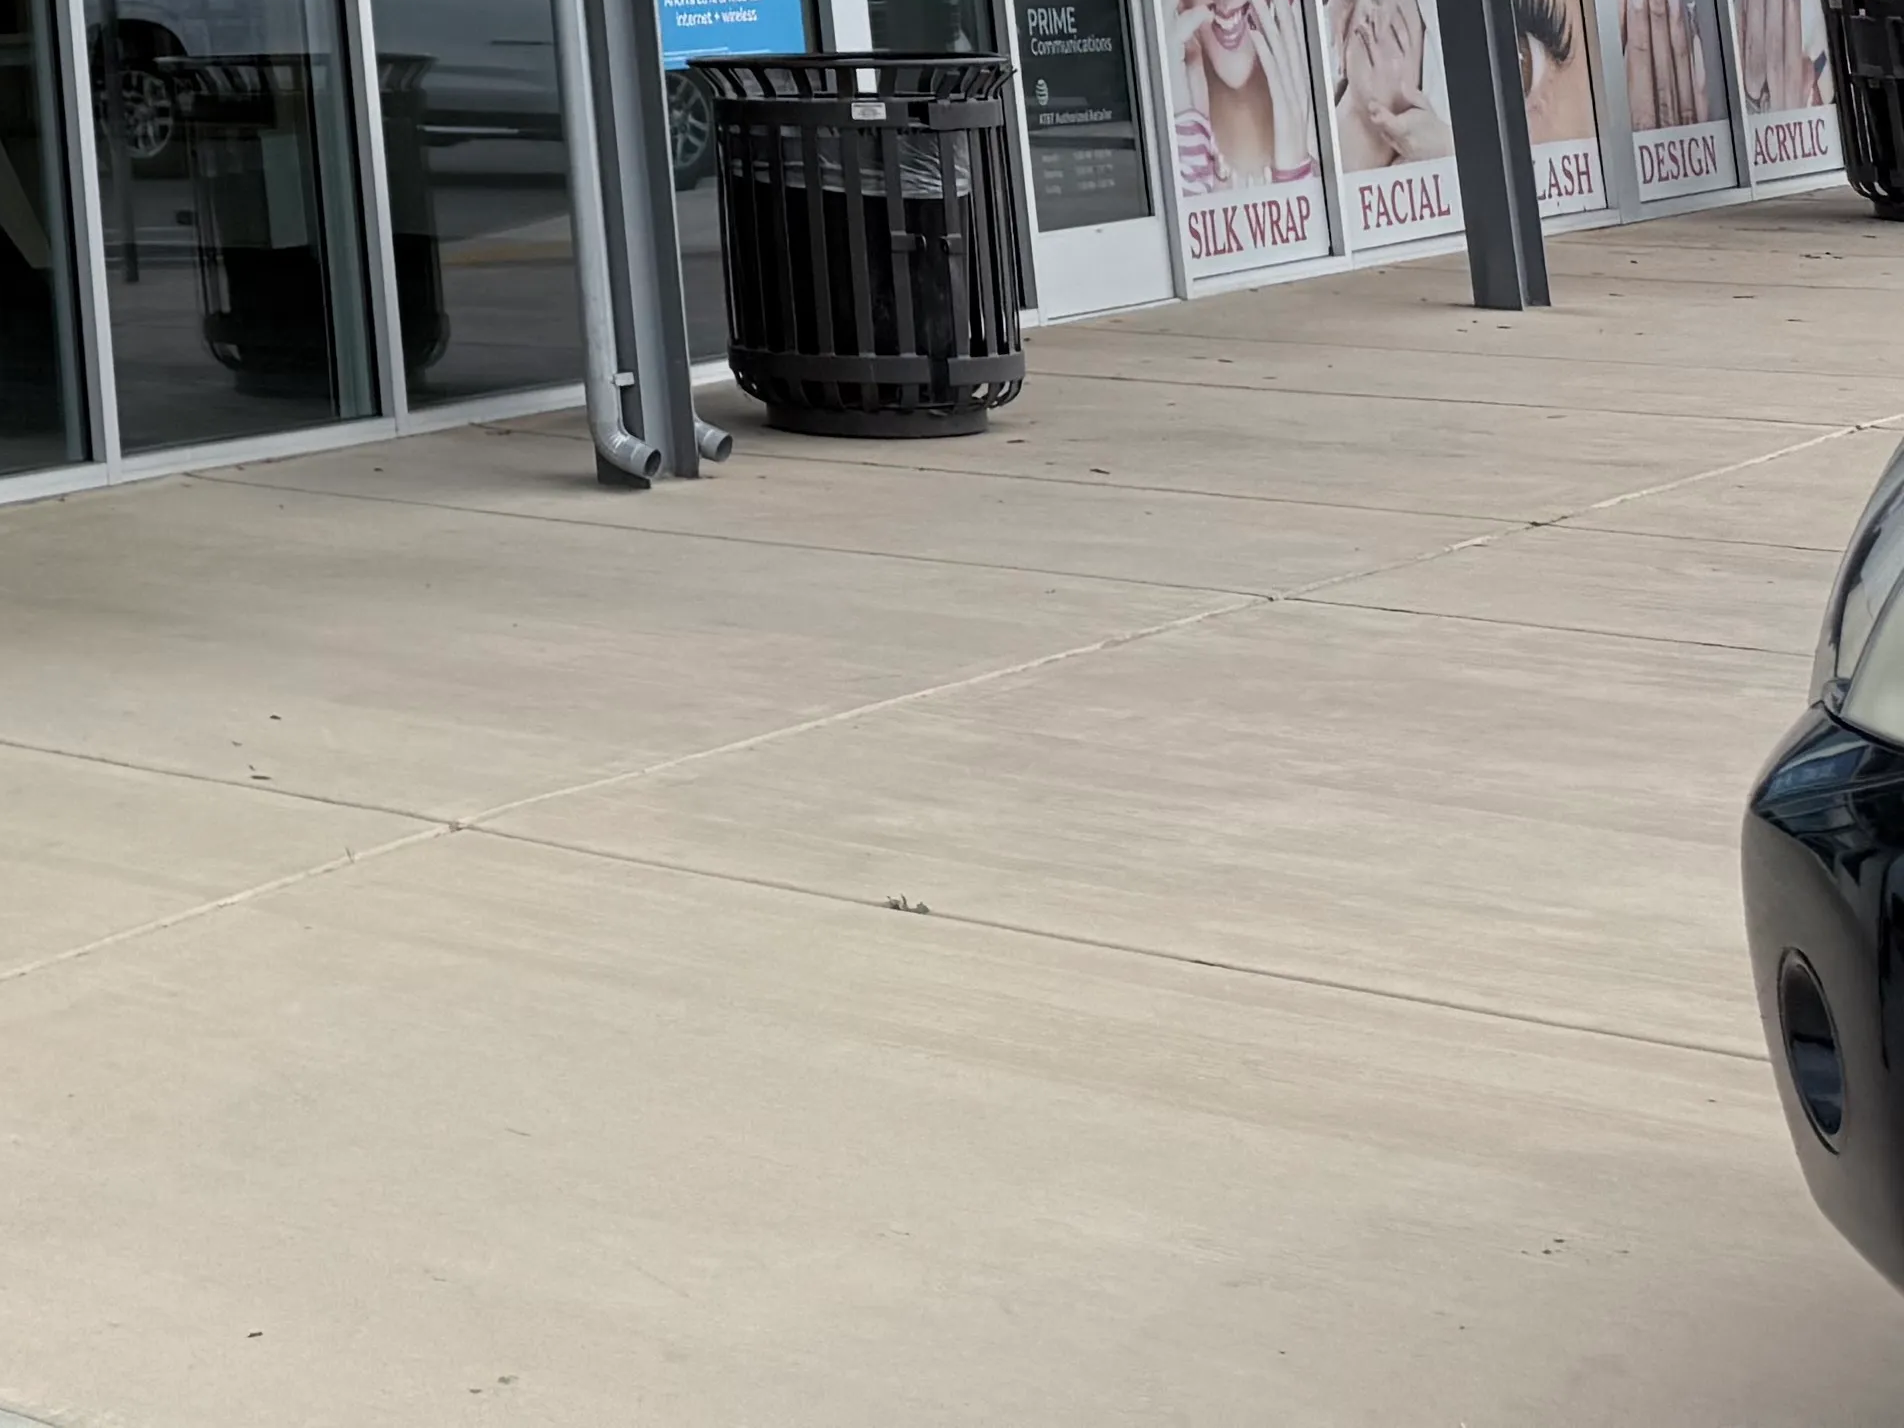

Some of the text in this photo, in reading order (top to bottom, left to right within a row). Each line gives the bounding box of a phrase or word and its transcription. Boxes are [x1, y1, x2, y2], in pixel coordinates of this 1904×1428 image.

[676, 11, 713, 27] internet
[721, 6, 757, 23] wireless
[1027, 6, 1078, 36] PRIME
[1031, 35, 1113, 56] Communications
[1639, 135, 1718, 185] DESIGN
[1754, 118, 1829, 166] ACRYLIC
[1359, 174, 1451, 230] FACIAL
[1188, 195, 1311, 259] SILK WRAP
